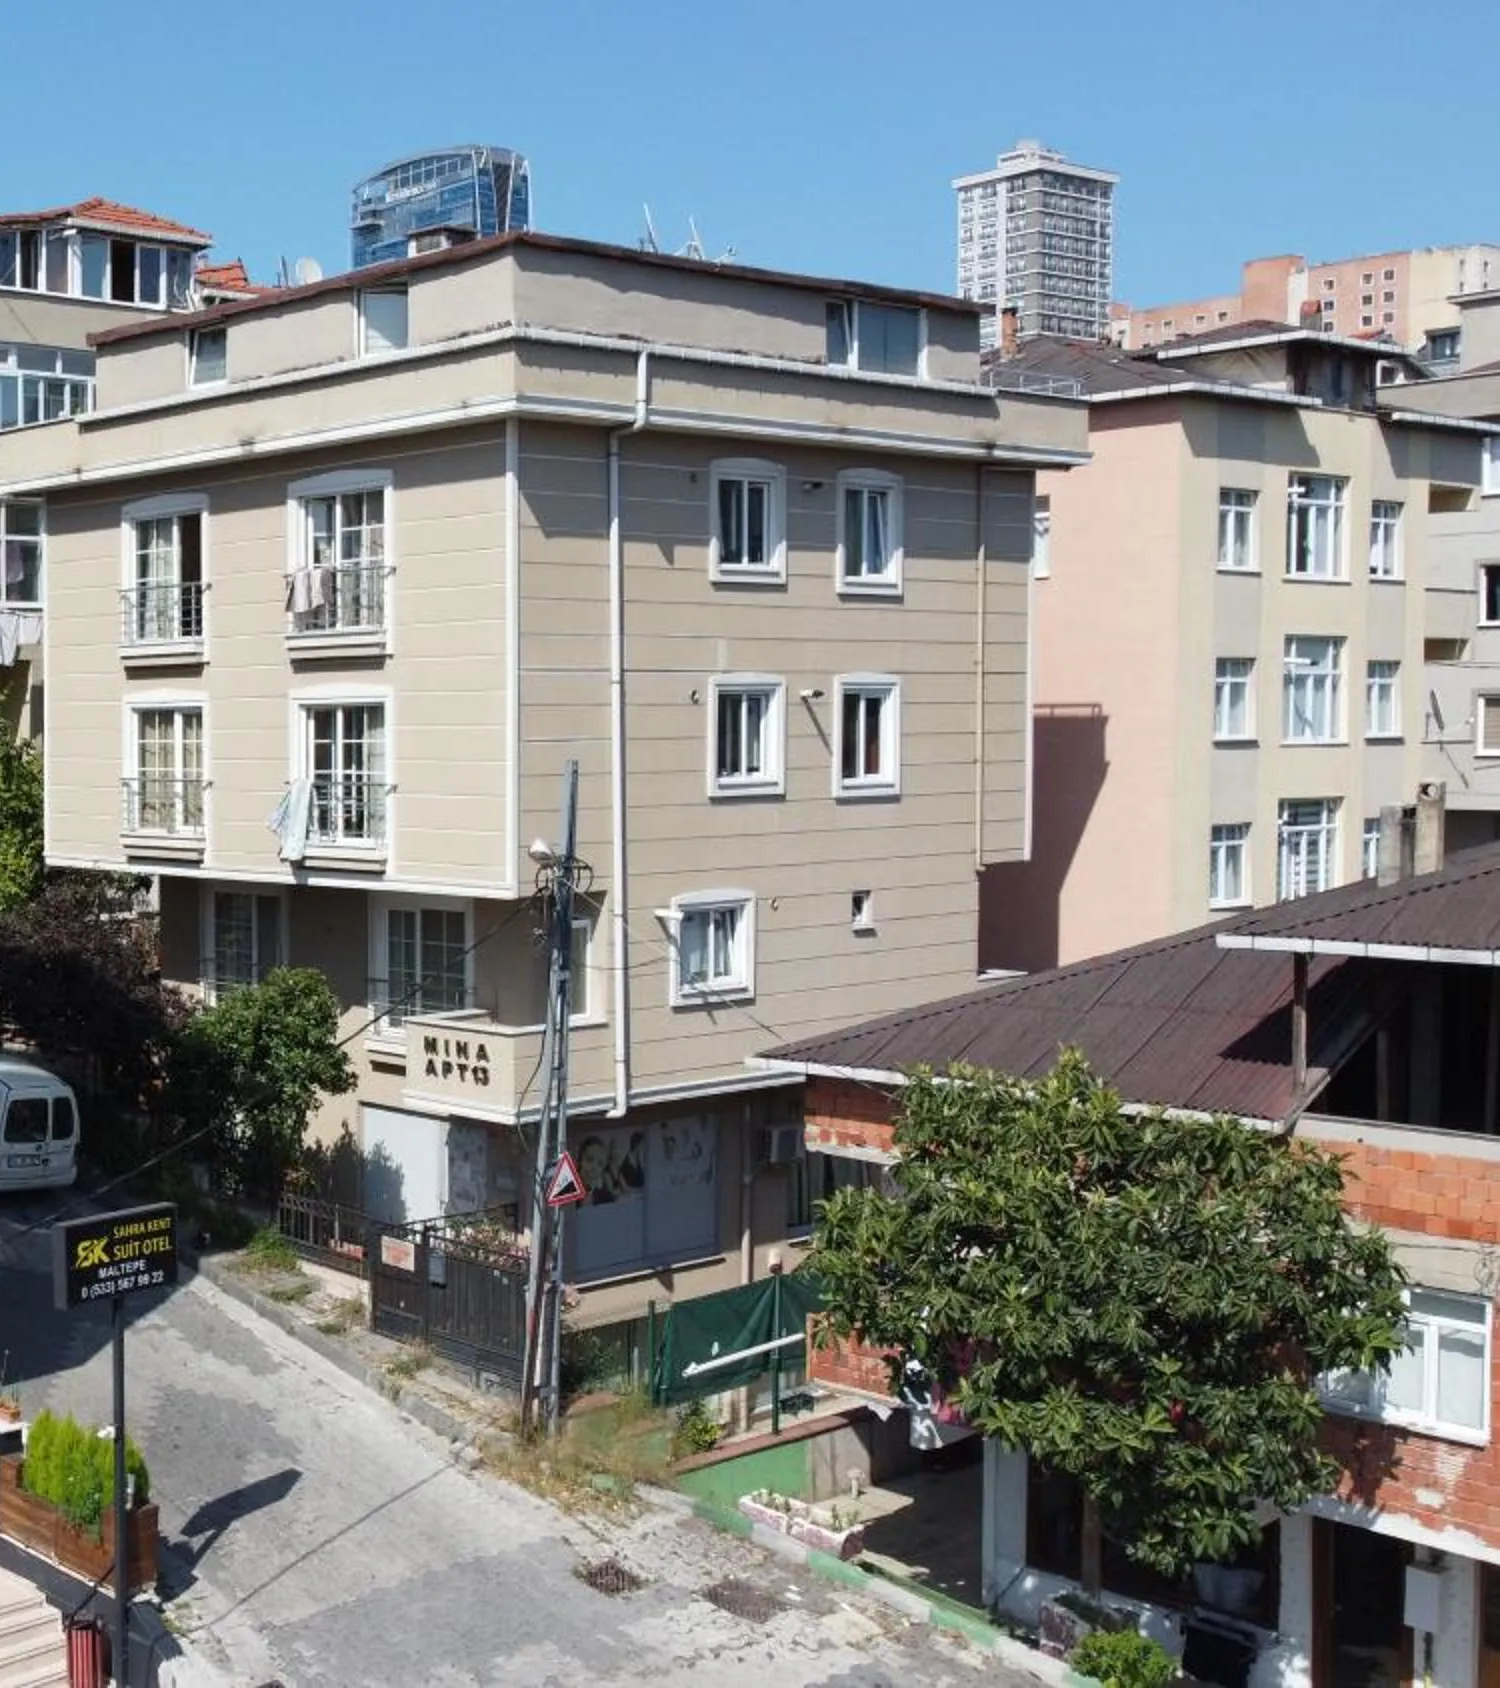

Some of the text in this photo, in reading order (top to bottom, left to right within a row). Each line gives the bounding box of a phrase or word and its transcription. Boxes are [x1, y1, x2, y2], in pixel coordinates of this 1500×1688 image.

[113, 1217, 172, 1239] SAHRA KENT
[75, 1236, 110, 1268] SK
[143, 1236, 173, 1255] OTEL
[98, 1260, 146, 1279] MALTEPE
